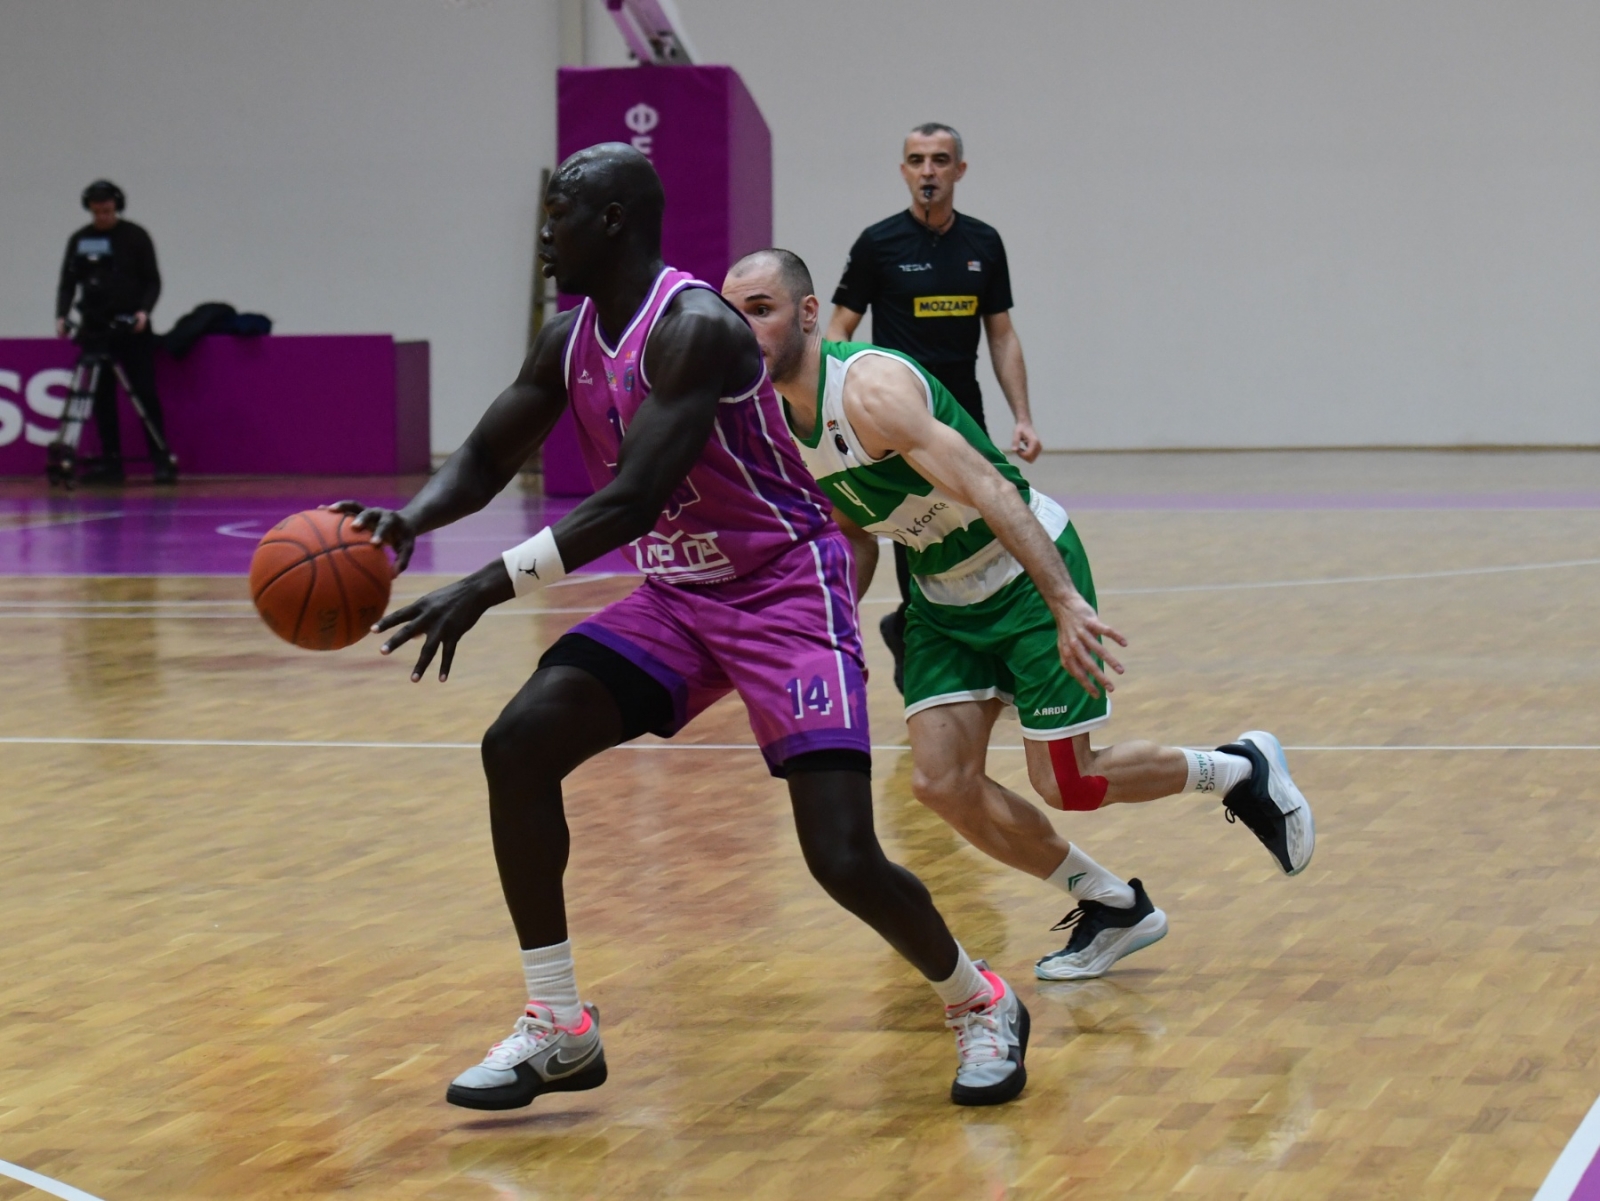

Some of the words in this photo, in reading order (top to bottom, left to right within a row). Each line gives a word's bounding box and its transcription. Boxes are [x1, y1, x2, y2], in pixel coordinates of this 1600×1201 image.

[919, 301, 974, 311] MOZZART
[785, 675, 832, 719] 14
[1041, 705, 1068, 716] ARDU
